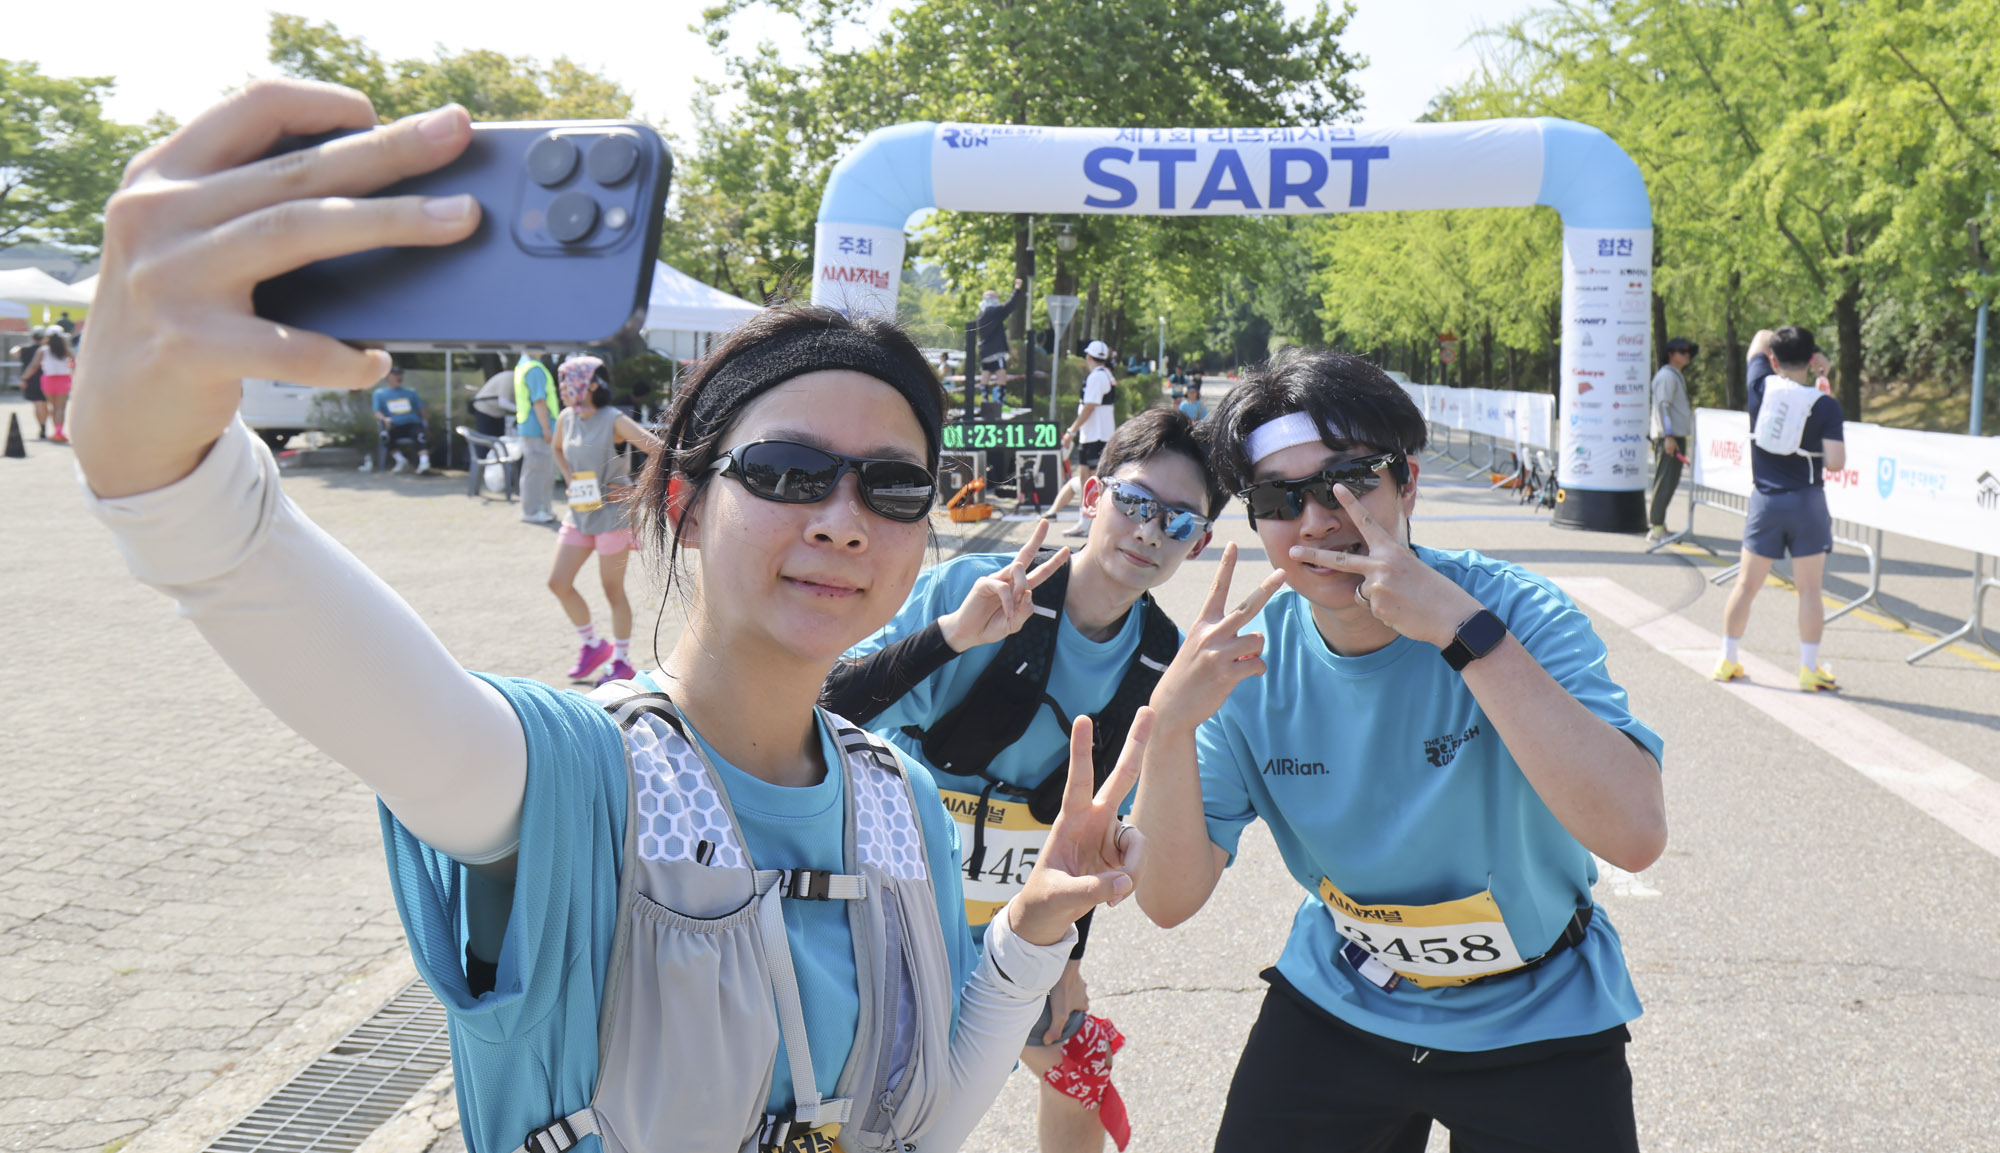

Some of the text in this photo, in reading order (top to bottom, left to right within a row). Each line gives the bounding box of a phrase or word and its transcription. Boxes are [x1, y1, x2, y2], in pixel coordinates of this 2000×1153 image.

[1083, 146, 1389, 210] START
[839, 236, 873, 255] 주최
[1598, 238, 1633, 257] 협찬
[821, 266, 889, 290] 시사저널
[943, 424, 1057, 448] 01:23:11.20
[1424, 738, 1440, 748] THE
[1329, 891, 1403, 923] 시사저널
[1343, 925, 1501, 964] 3458
